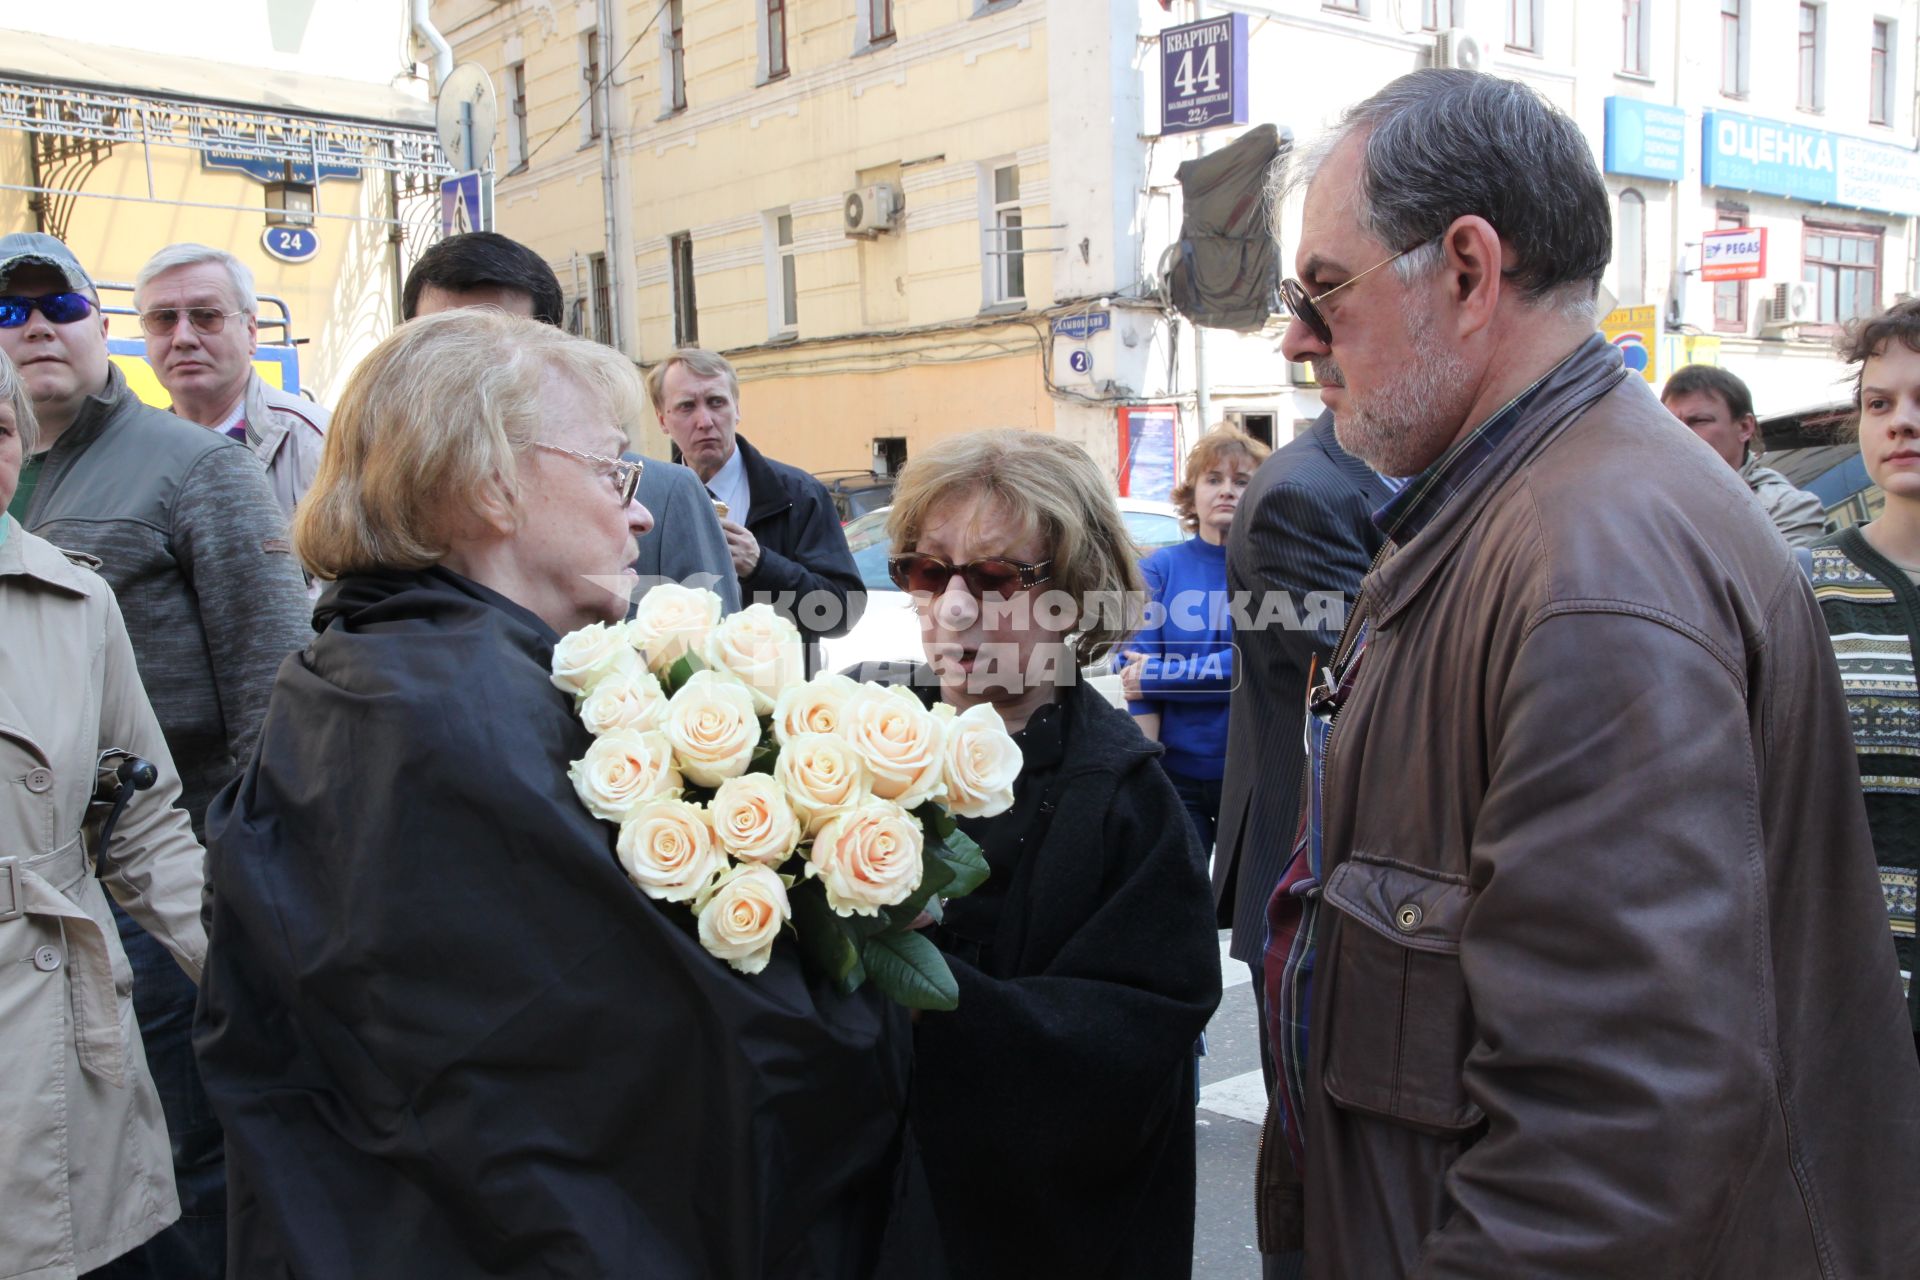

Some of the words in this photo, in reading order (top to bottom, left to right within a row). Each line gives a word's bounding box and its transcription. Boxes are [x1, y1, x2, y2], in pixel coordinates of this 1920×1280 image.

[1167, 24, 1228, 53] КВАРТИРА
[1174, 45, 1220, 97] 44
[1717, 119, 1834, 173] ОЦЕНКА
[280, 232, 302, 250] 24
[1726, 242, 1760, 254] PEGAS
[1076, 353, 1084, 370] 2
